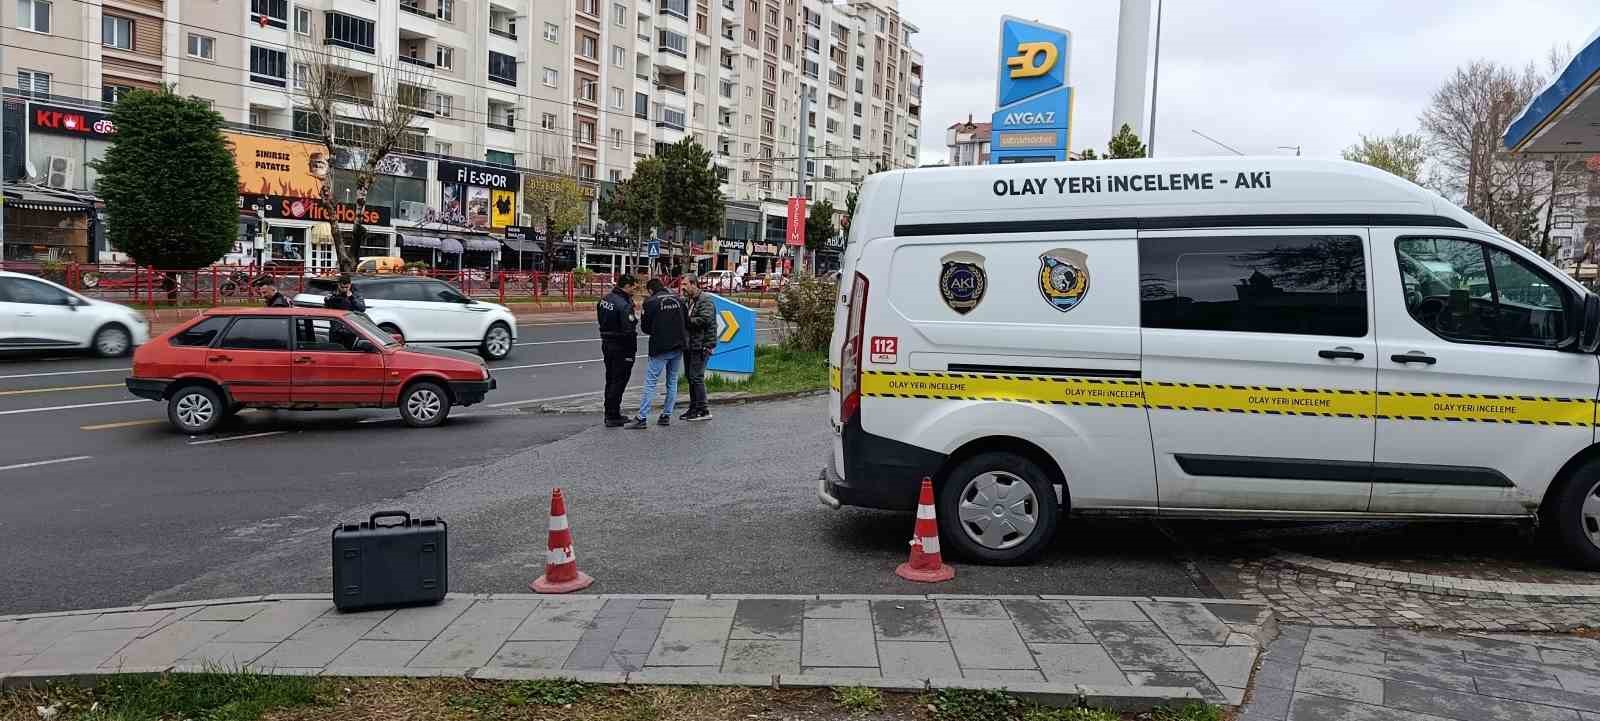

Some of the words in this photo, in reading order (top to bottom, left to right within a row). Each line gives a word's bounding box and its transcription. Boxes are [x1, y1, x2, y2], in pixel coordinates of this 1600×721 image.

[1004, 111, 1055, 125] AYGAZ
[256, 161, 290, 172] PATATES
[470, 169, 507, 188] E-SPOR
[993, 178, 1048, 196] OLAY
[336, 203, 380, 224] Hose
[874, 339, 895, 353] 112
[888, 380, 908, 389] OLAY
[1065, 388, 1085, 396] OLAY
[1248, 396, 1268, 404] OLAY
[1433, 403, 1454, 411] OLAY
